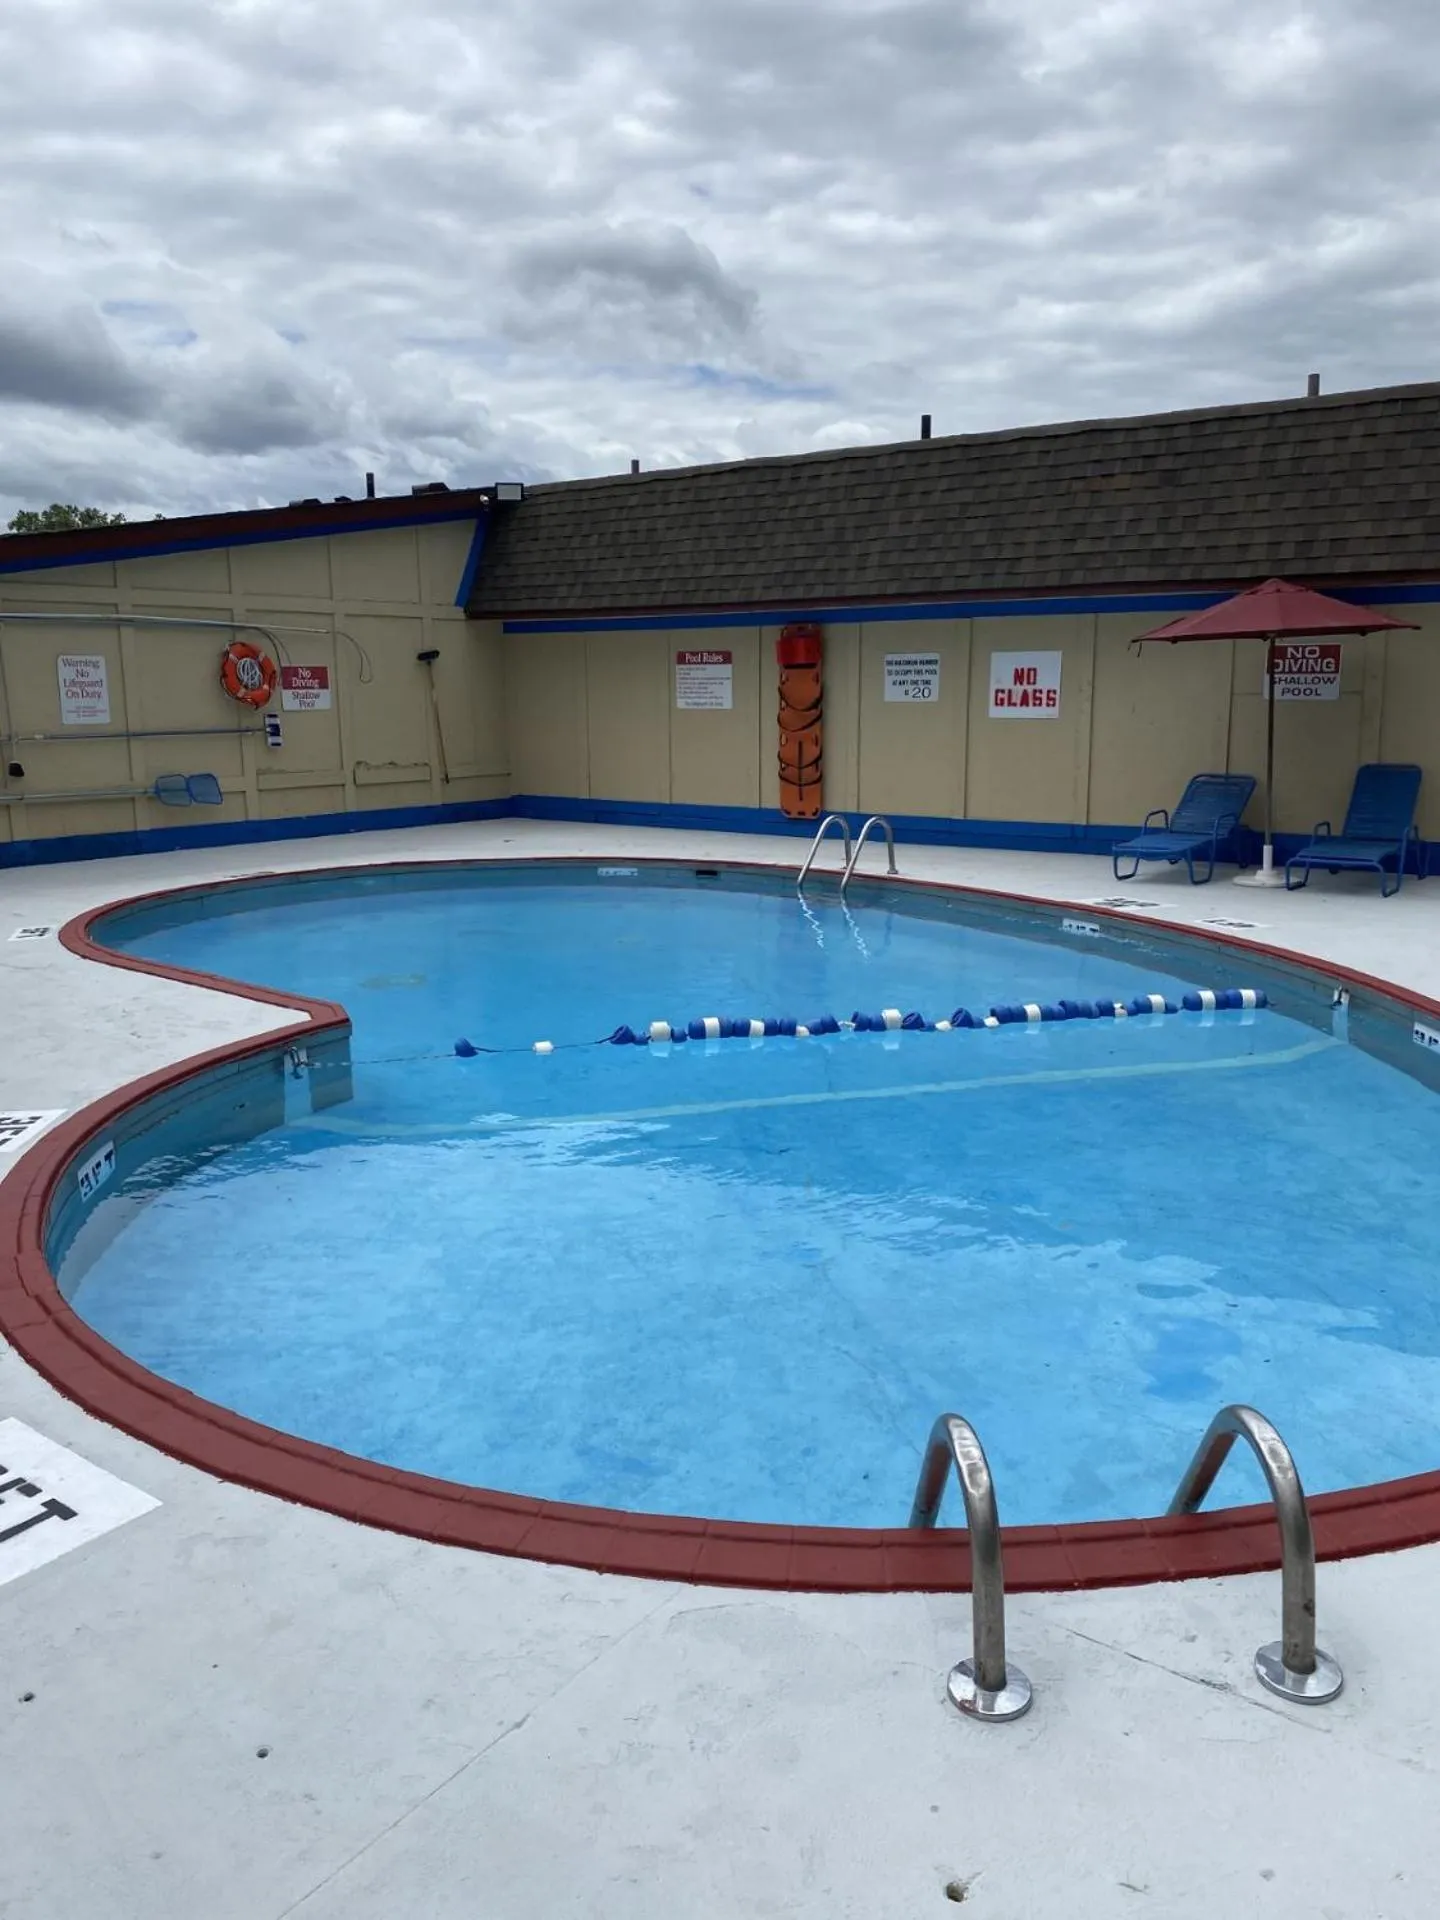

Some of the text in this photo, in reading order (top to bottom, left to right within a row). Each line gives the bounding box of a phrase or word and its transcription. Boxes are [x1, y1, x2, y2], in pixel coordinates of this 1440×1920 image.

[685, 652, 701, 663] Pool
[1287, 646, 1320, 659] NO
[75, 669, 89, 678] No
[297, 667, 312, 678] No
[1013, 666, 1037, 686] NO
[63, 679, 103, 689] Lifeguard
[292, 677, 320, 688] Diving
[66, 689, 102, 700] On Duty
[292, 690, 321, 700] Shallow
[911, 687, 932, 698] 20
[994, 688, 1057, 707] GLASS
[1281, 687, 1322, 697] POOL
[299, 699, 316, 709] Pool
